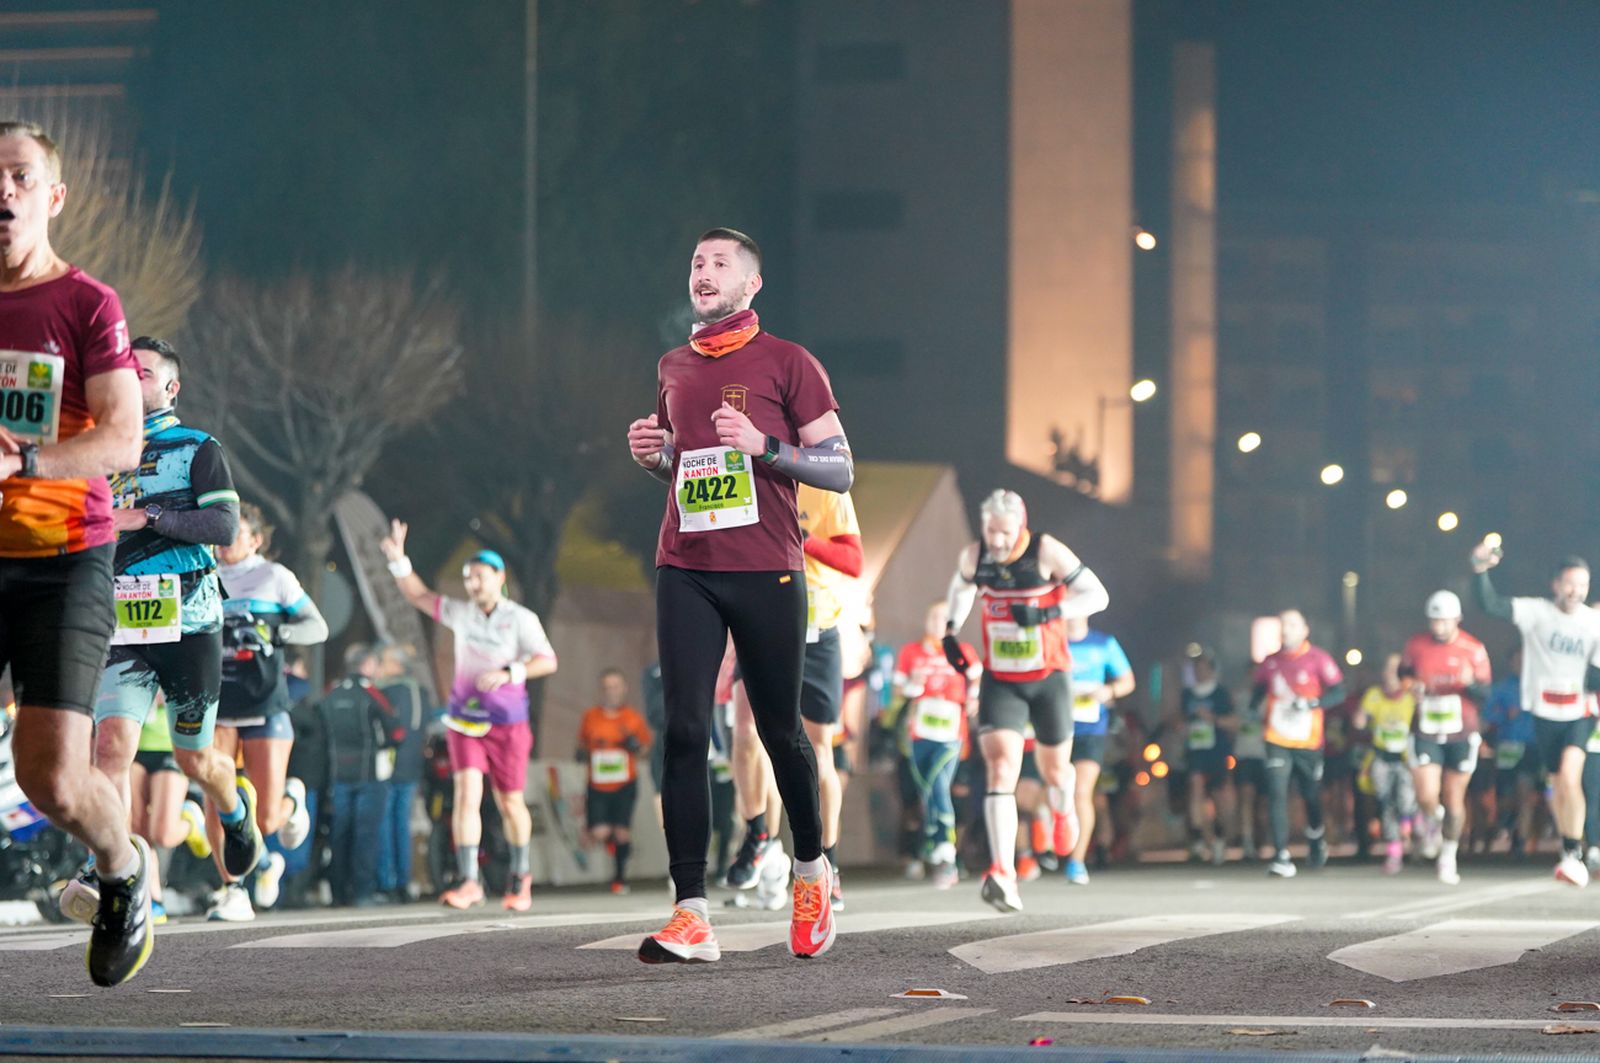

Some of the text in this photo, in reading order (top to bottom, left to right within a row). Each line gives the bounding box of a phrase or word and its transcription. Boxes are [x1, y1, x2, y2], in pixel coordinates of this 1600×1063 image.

[0, 390, 46, 423] 06
[707, 456, 717, 466] DE
[691, 465, 719, 478] ANTÓN
[683, 475, 738, 504] 2422
[142, 582, 151, 590] DE
[128, 591, 152, 599] ANTÓN
[124, 599, 163, 621] 1172
